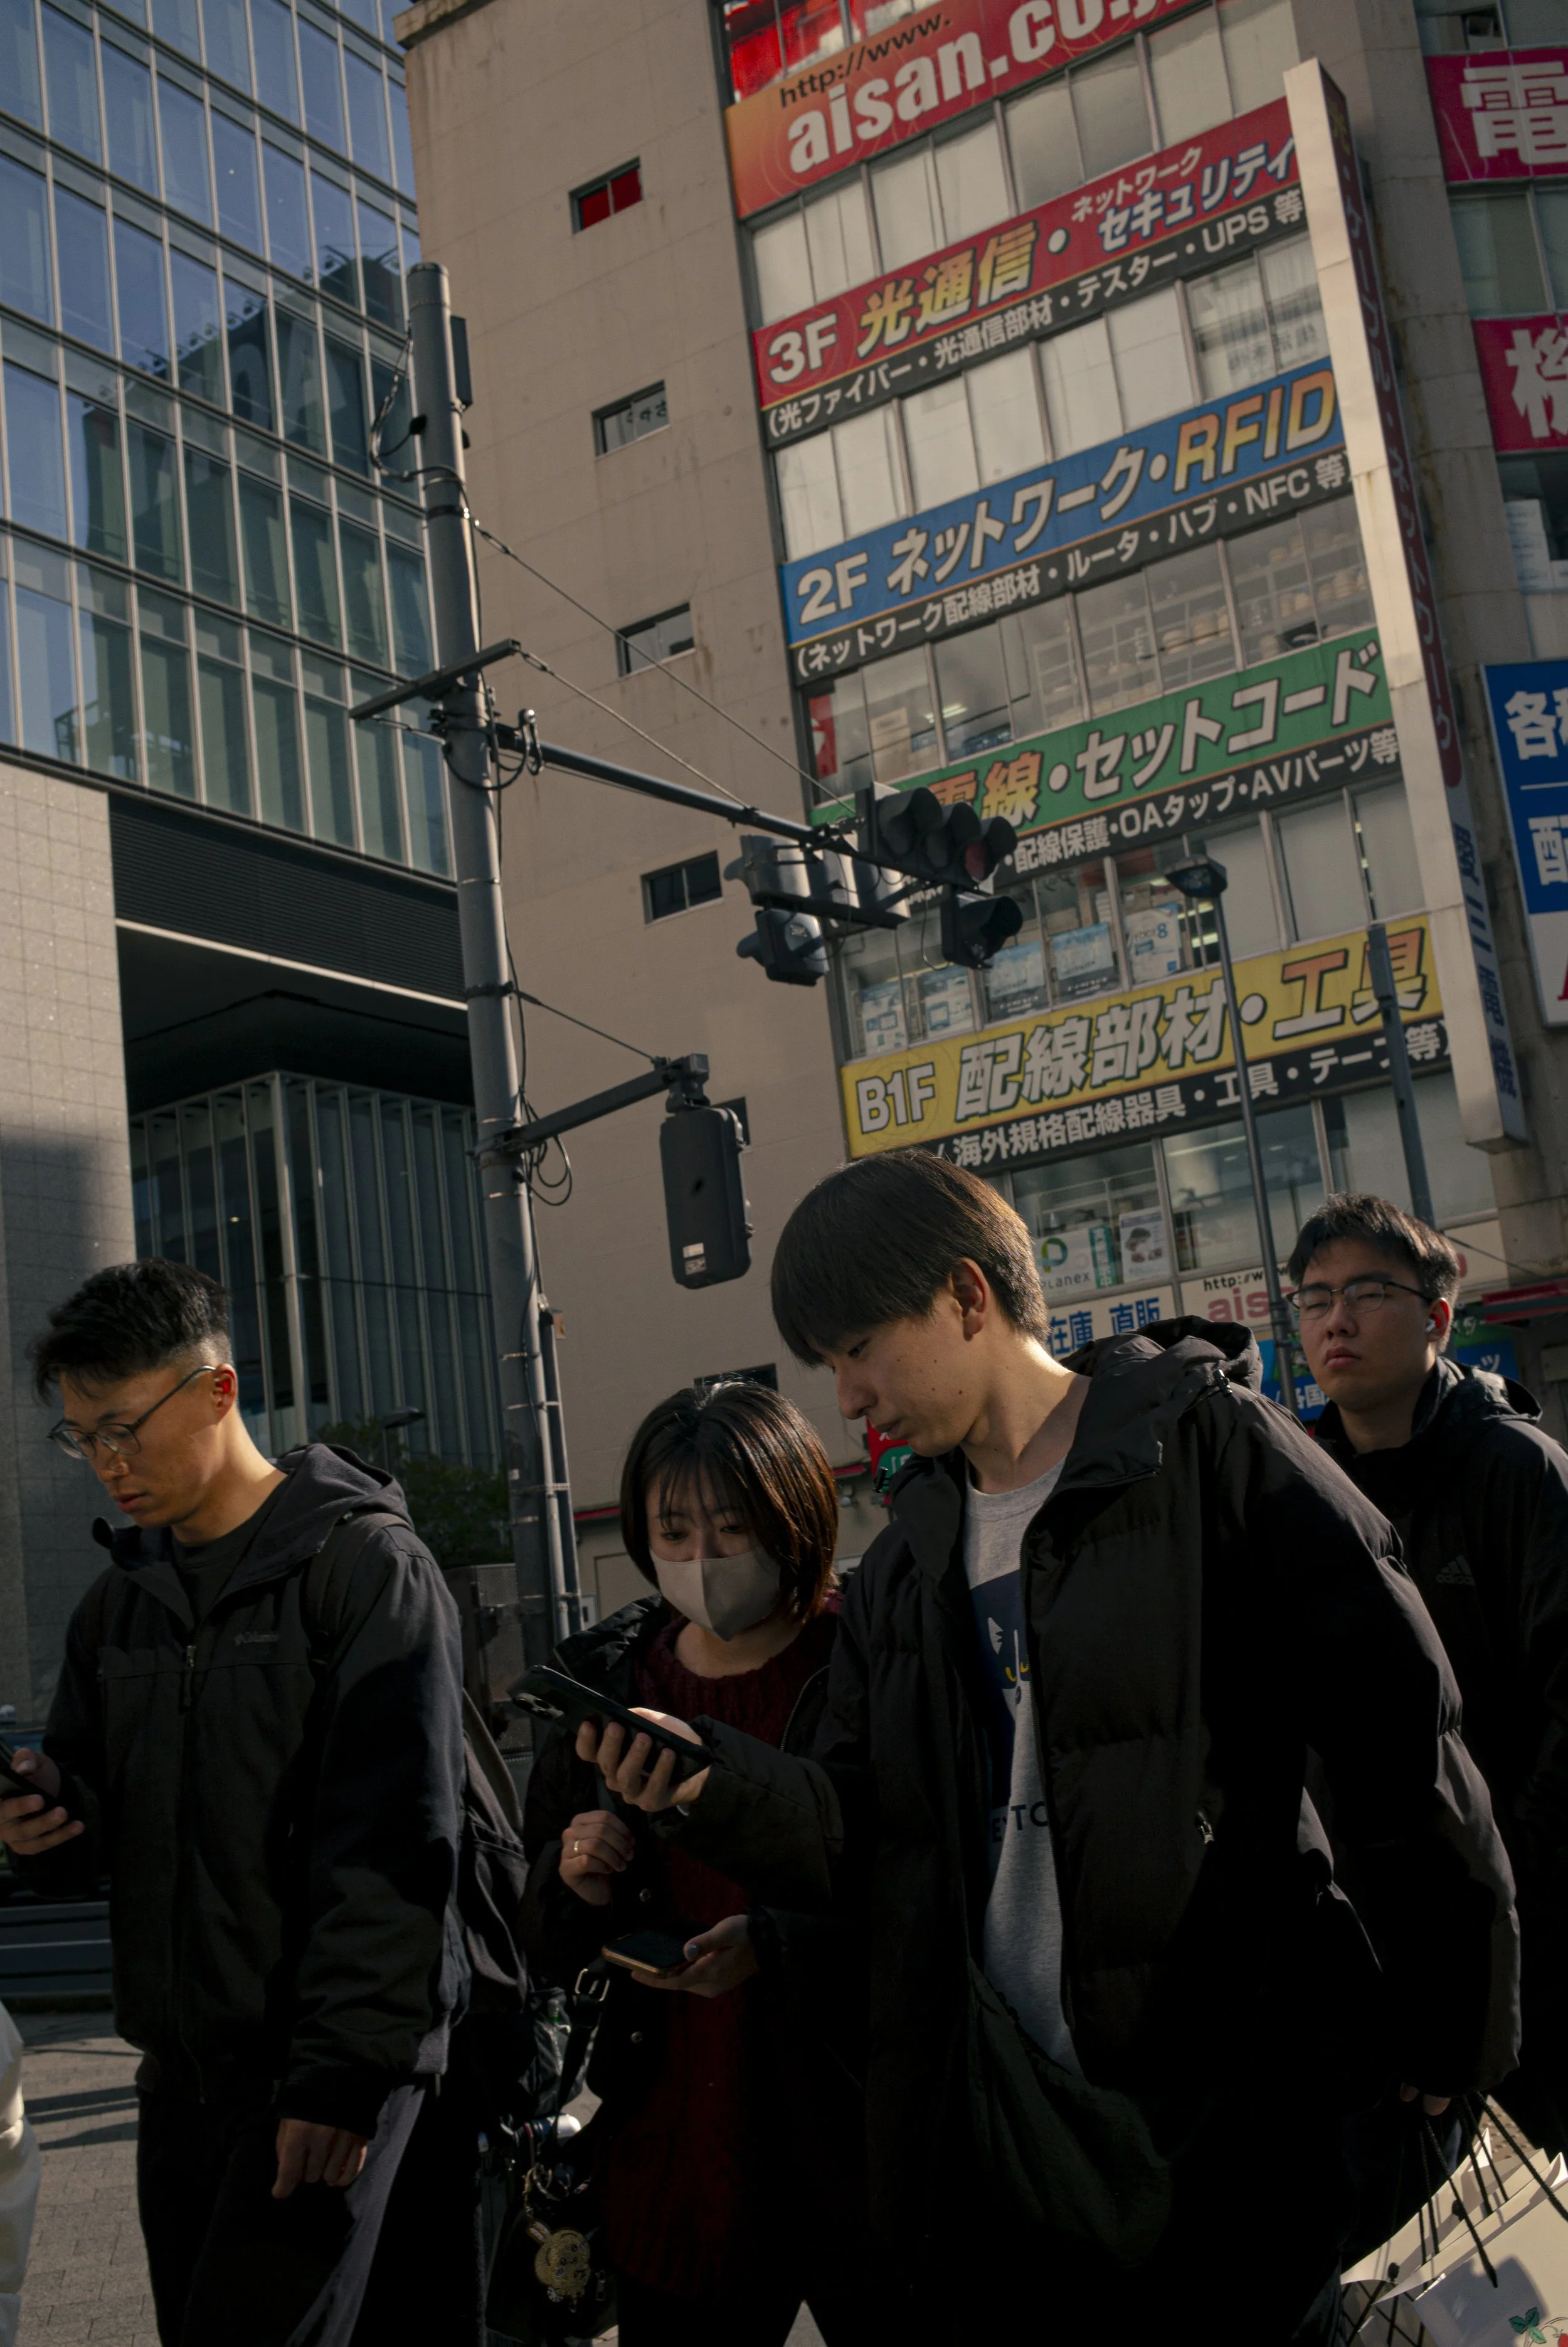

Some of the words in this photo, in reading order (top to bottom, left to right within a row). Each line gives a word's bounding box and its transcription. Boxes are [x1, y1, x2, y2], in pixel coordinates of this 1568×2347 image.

[780, 14, 950, 109] http://www.
[788, 0, 1182, 173] aisan.co.
[1071, 147, 1202, 222] ネットワーク
[769, 313, 837, 384] 3F
[798, 551, 869, 625] 2F
[886, 369, 1336, 595] ネットワーク・RFID
[857, 1062, 936, 1134] B1F
[955, 926, 1428, 1124] 配線部材・工具
